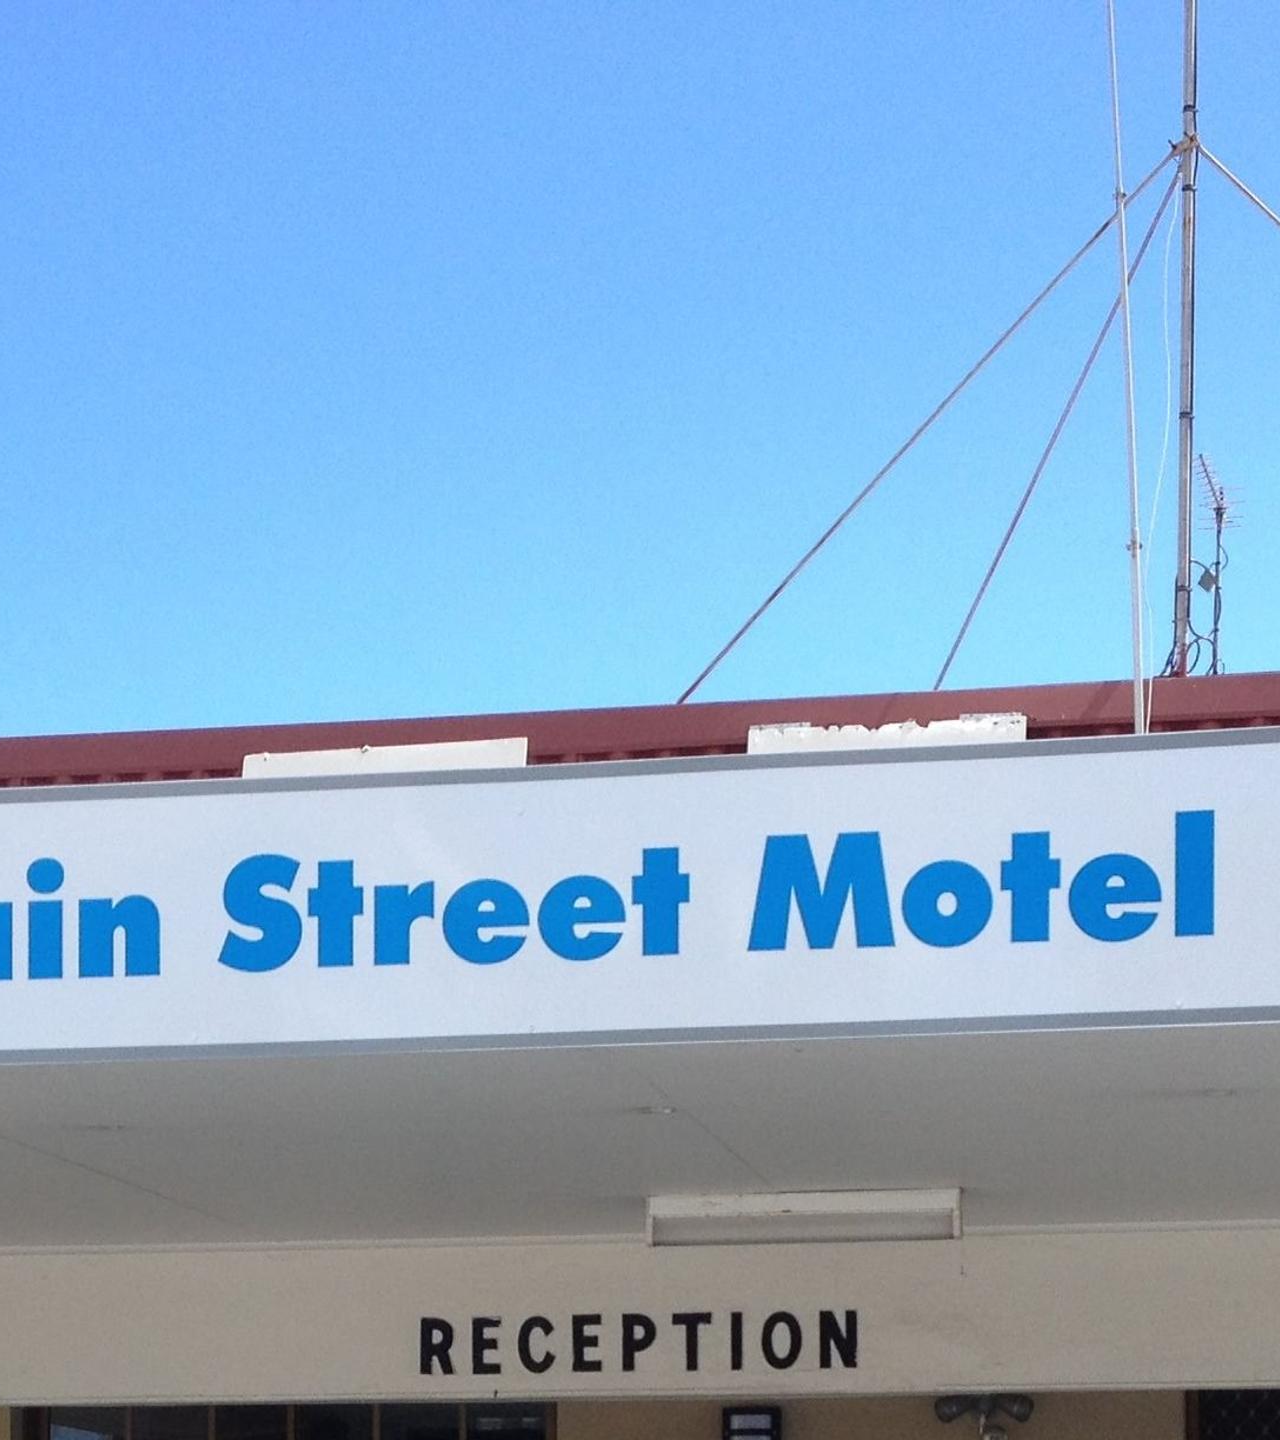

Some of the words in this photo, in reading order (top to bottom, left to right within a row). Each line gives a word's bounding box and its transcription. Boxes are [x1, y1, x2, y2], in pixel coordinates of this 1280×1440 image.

[218, 846, 691, 972] Street
[748, 809, 1217, 950] Motel
[419, 1310, 858, 1376] RECEPTION
